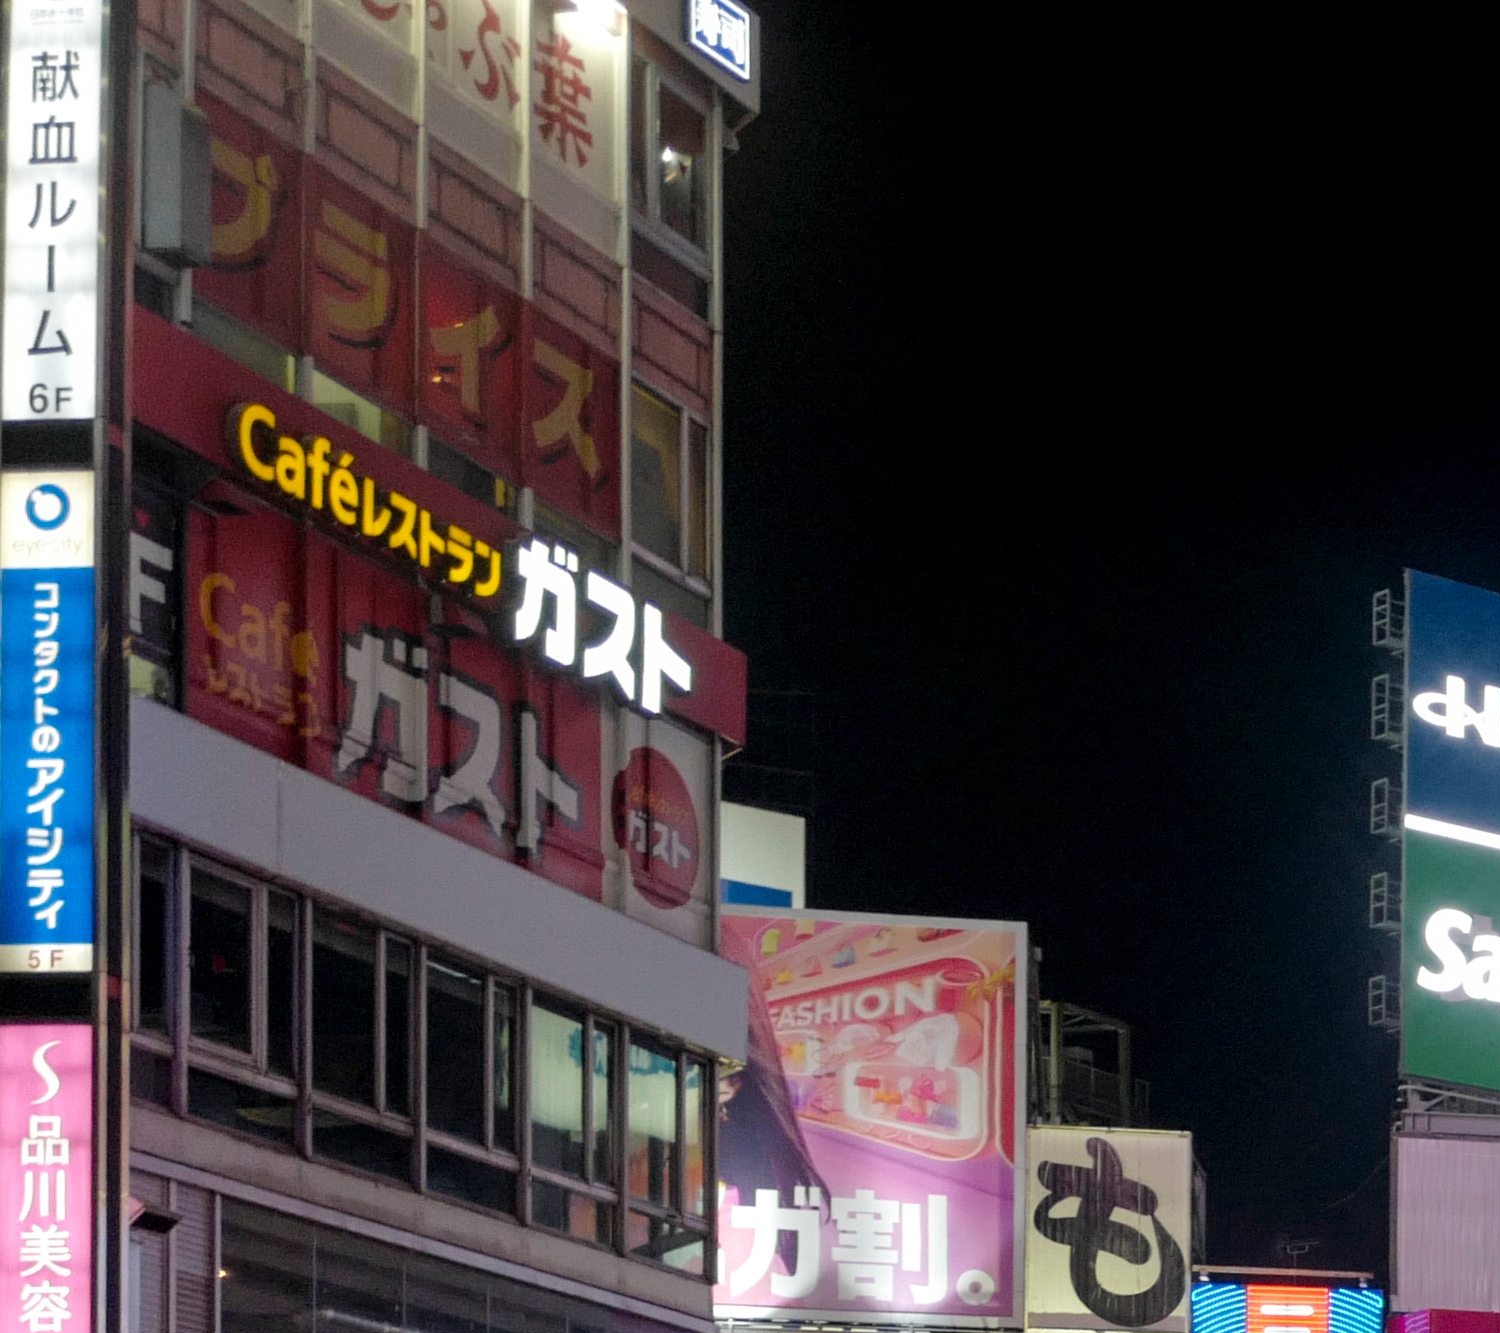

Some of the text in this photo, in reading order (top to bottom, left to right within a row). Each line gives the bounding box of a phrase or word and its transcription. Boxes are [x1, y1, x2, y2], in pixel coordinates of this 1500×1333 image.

[27, 52, 80, 358] 献血ルーム
[28, 384, 74, 414] 6F
[12, 534, 83, 556] eyecity
[514, 537, 692, 715] ガスト
[26, 582, 65, 930] コンタクトのアイシティ
[340, 622, 581, 852] ガスト
[766, 976, 938, 1031] FASHION
[717, 1186, 996, 1306] ガ割。
